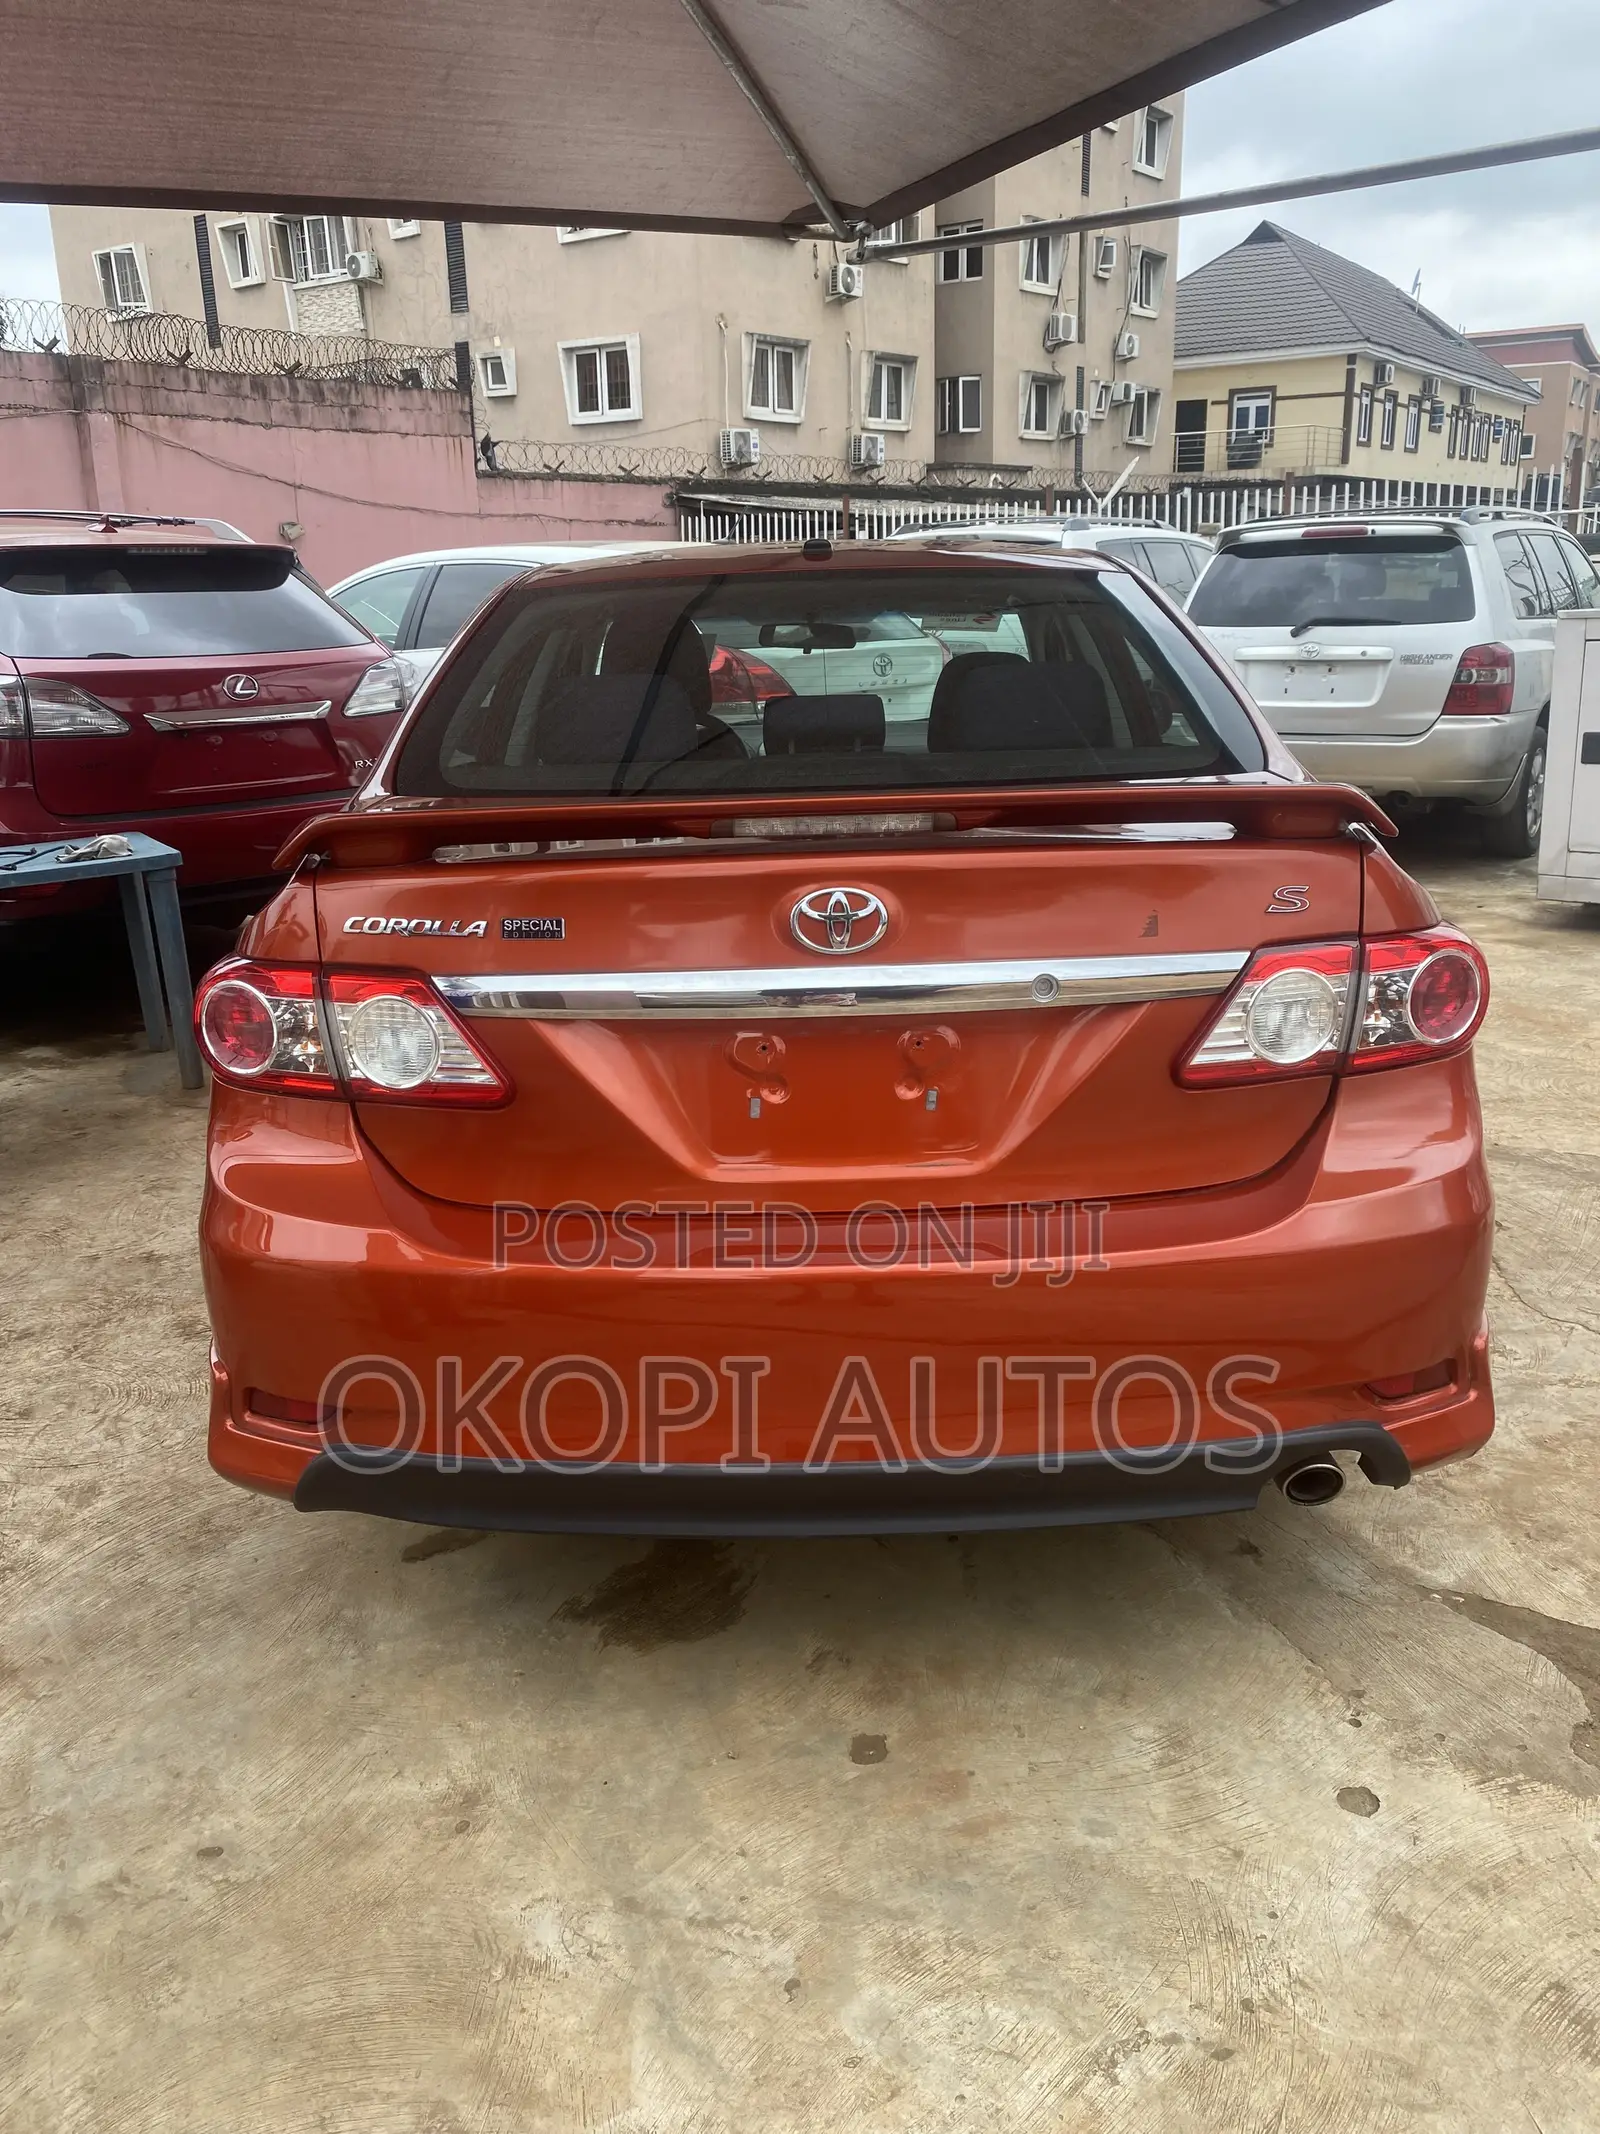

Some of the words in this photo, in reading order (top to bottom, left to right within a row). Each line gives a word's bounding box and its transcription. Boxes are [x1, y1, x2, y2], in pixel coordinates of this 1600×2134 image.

[354, 758, 378, 768] RX
[1265, 885, 1310, 913] S
[343, 916, 488, 937] COROLLA
[503, 919, 561, 931] SPECIAL
[503, 931, 562, 939] EDITION
